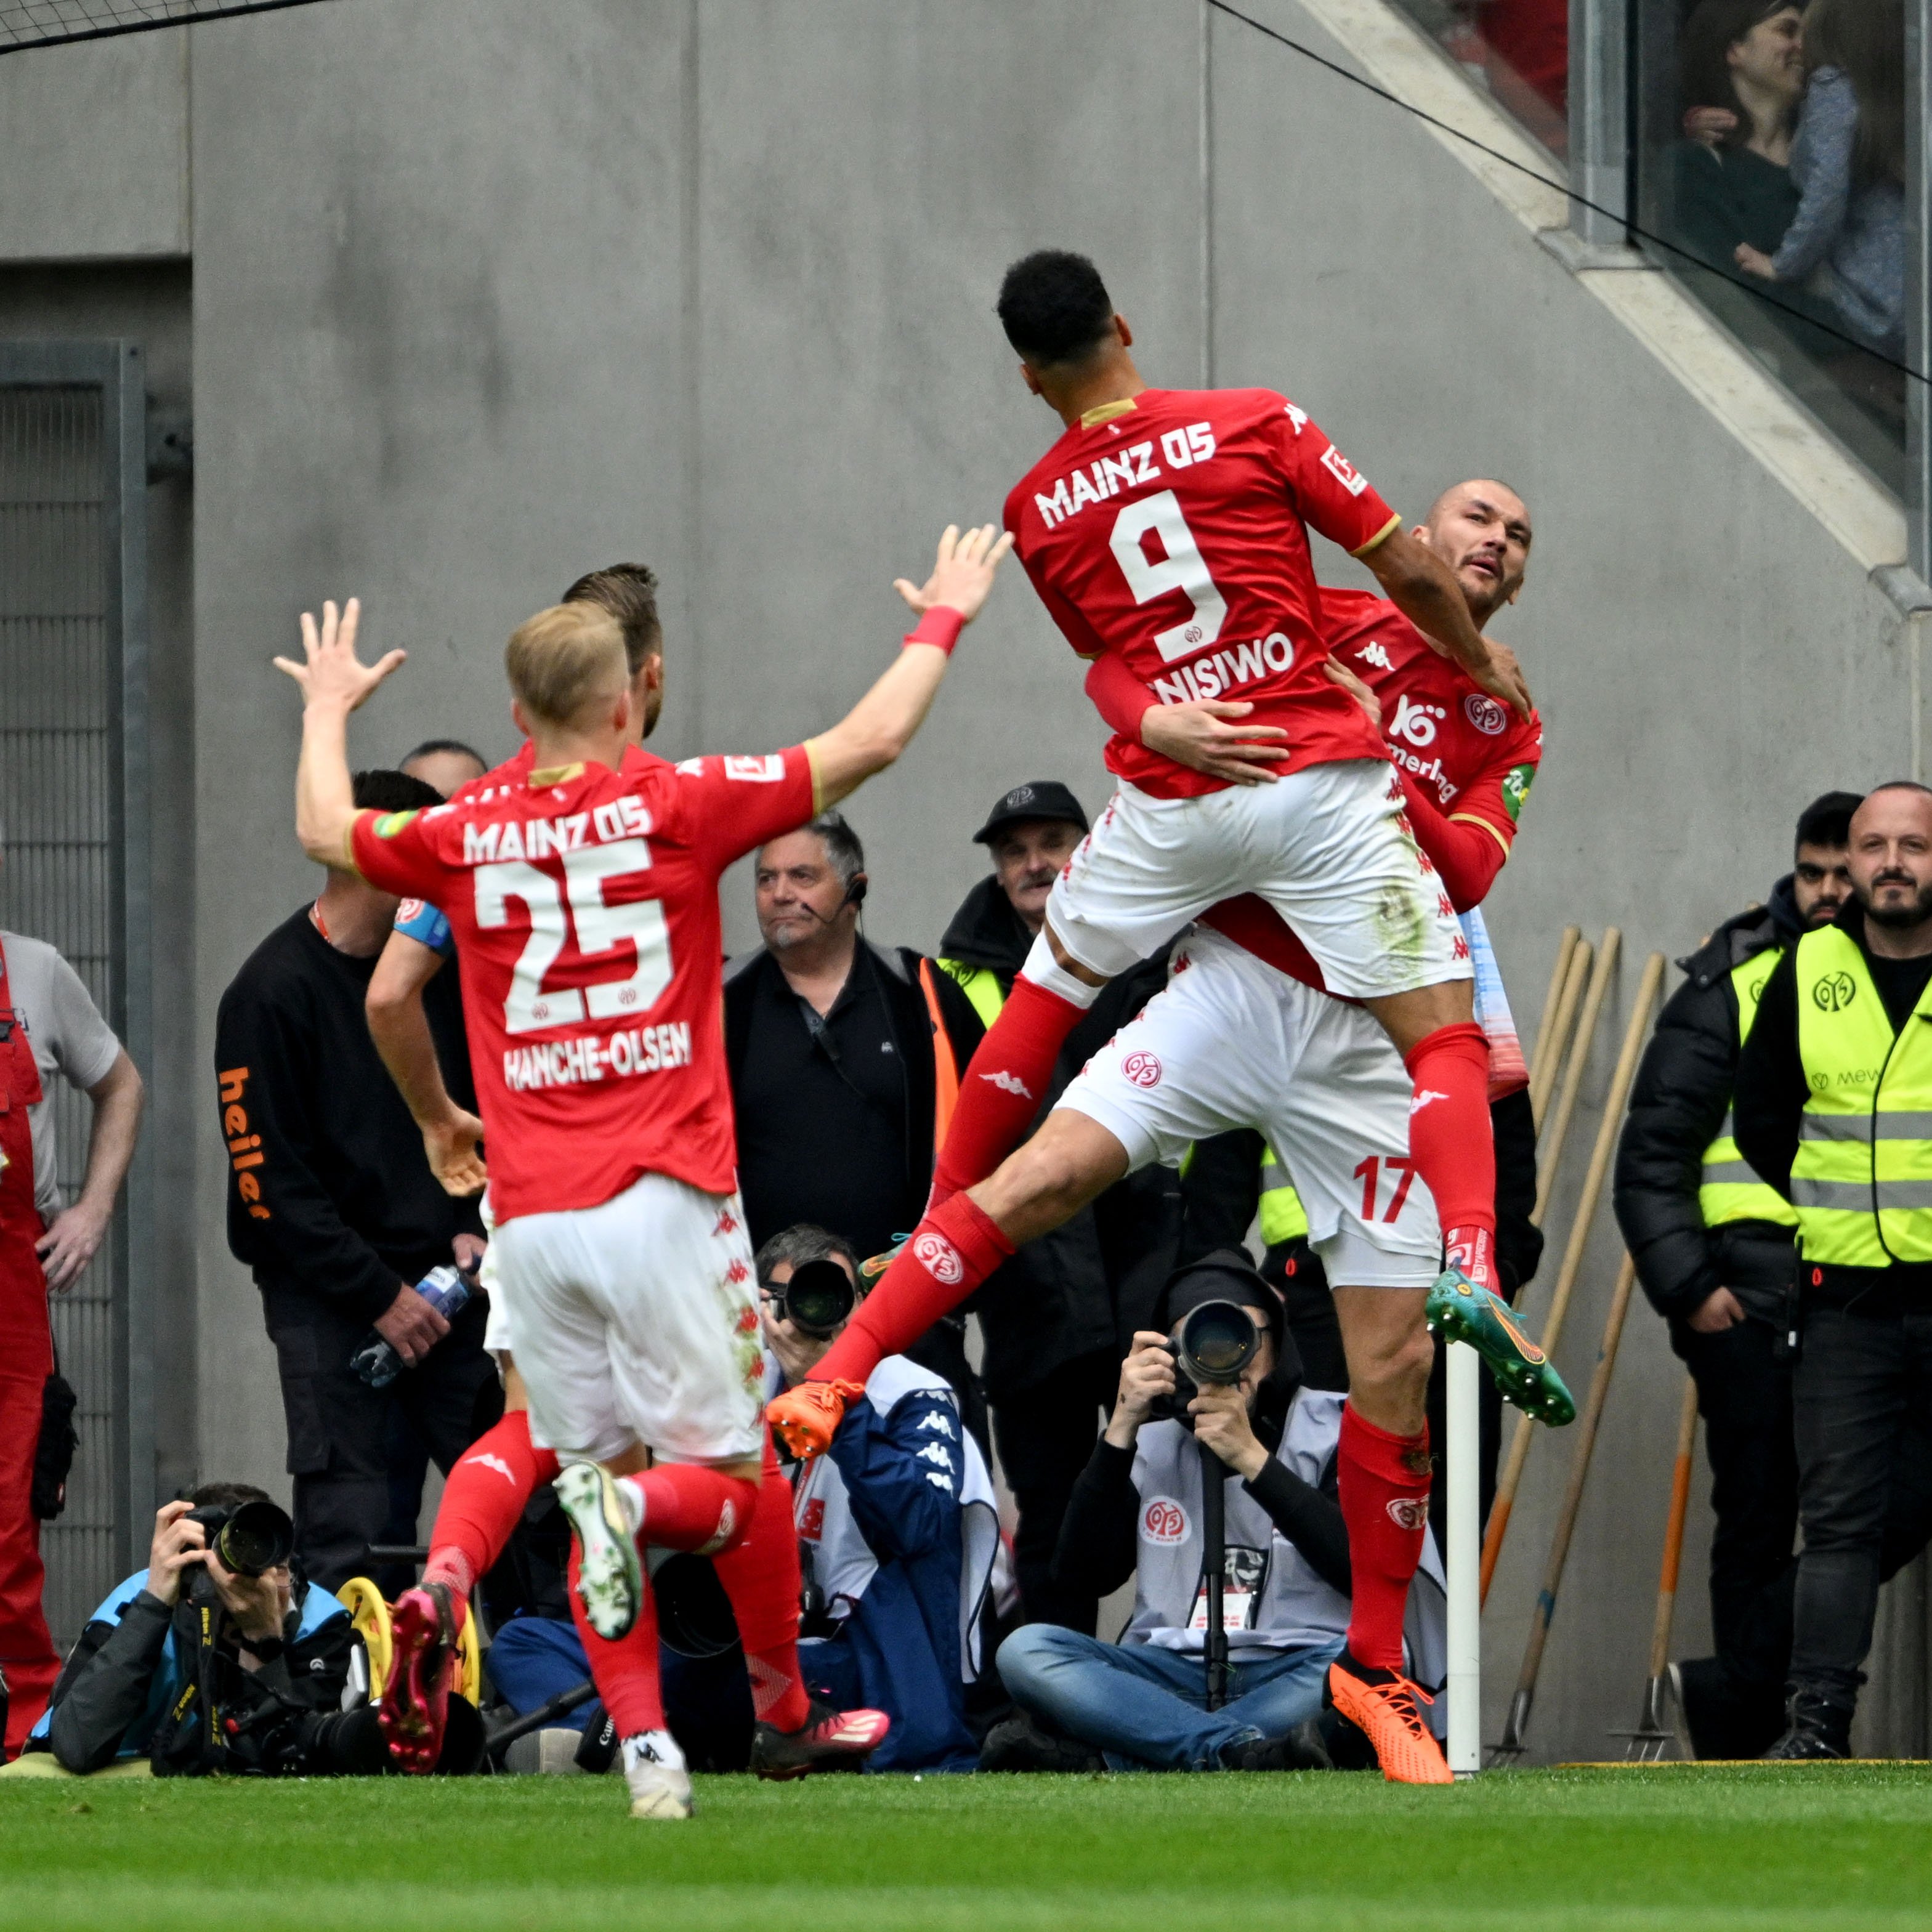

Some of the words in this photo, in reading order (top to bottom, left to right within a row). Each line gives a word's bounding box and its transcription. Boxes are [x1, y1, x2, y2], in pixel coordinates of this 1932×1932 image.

[1034, 440, 1161, 530] MAINZ
[1160, 421, 1217, 469] 05
[1109, 488, 1229, 663] 9
[1147, 632, 1294, 706] NISIWO
[463, 811, 588, 865] MAINZ
[593, 794, 651, 843] 05
[474, 838, 673, 1035] 25
[504, 1022, 691, 1091] HANCHE-OLSEN
[1353, 1155, 1416, 1224] 17
[201, 1607, 211, 1634] Nikon
[202, 1635, 212, 1648] Z
